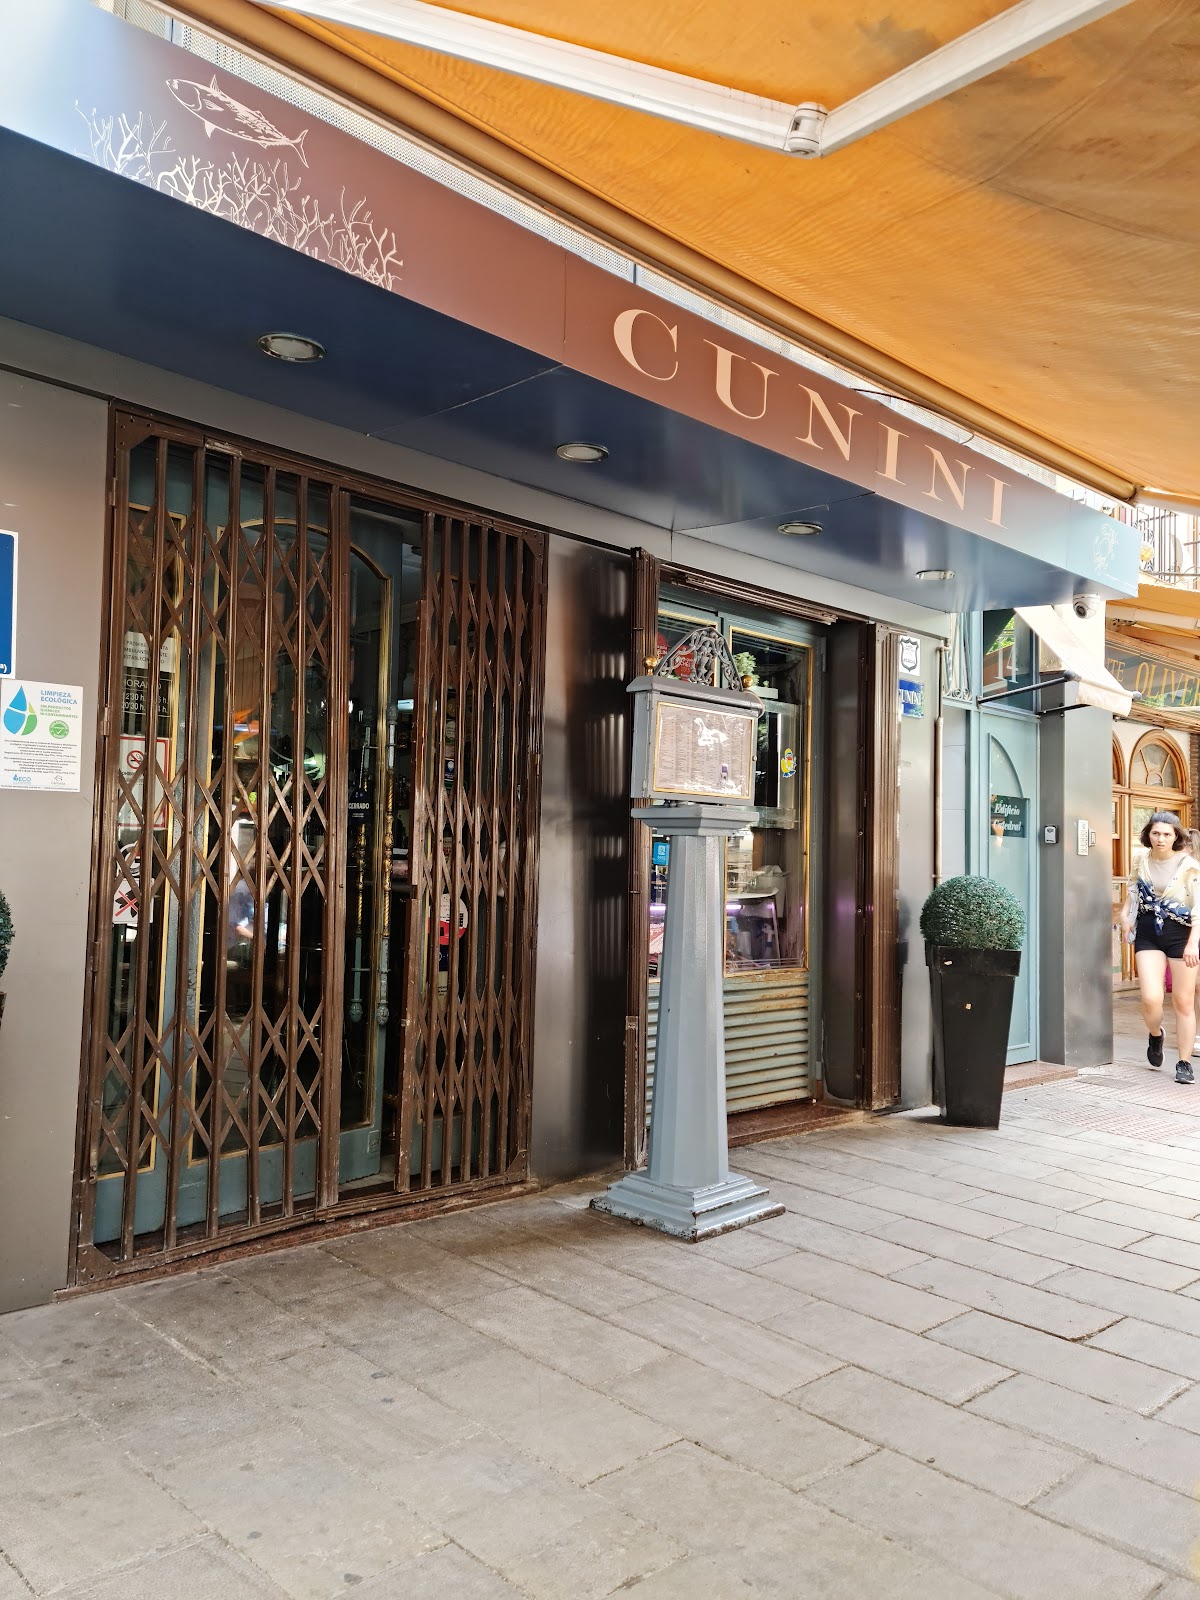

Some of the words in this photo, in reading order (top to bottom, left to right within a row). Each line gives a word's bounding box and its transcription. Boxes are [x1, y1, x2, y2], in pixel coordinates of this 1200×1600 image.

[613, 308, 1011, 529] CUNINI
[40, 690, 72, 698] LIMPIEZA
[40, 696, 78, 705] ECOLÓGICA
[348, 802, 370, 810] CERRADO
[994, 803, 1020, 817] Edificio
